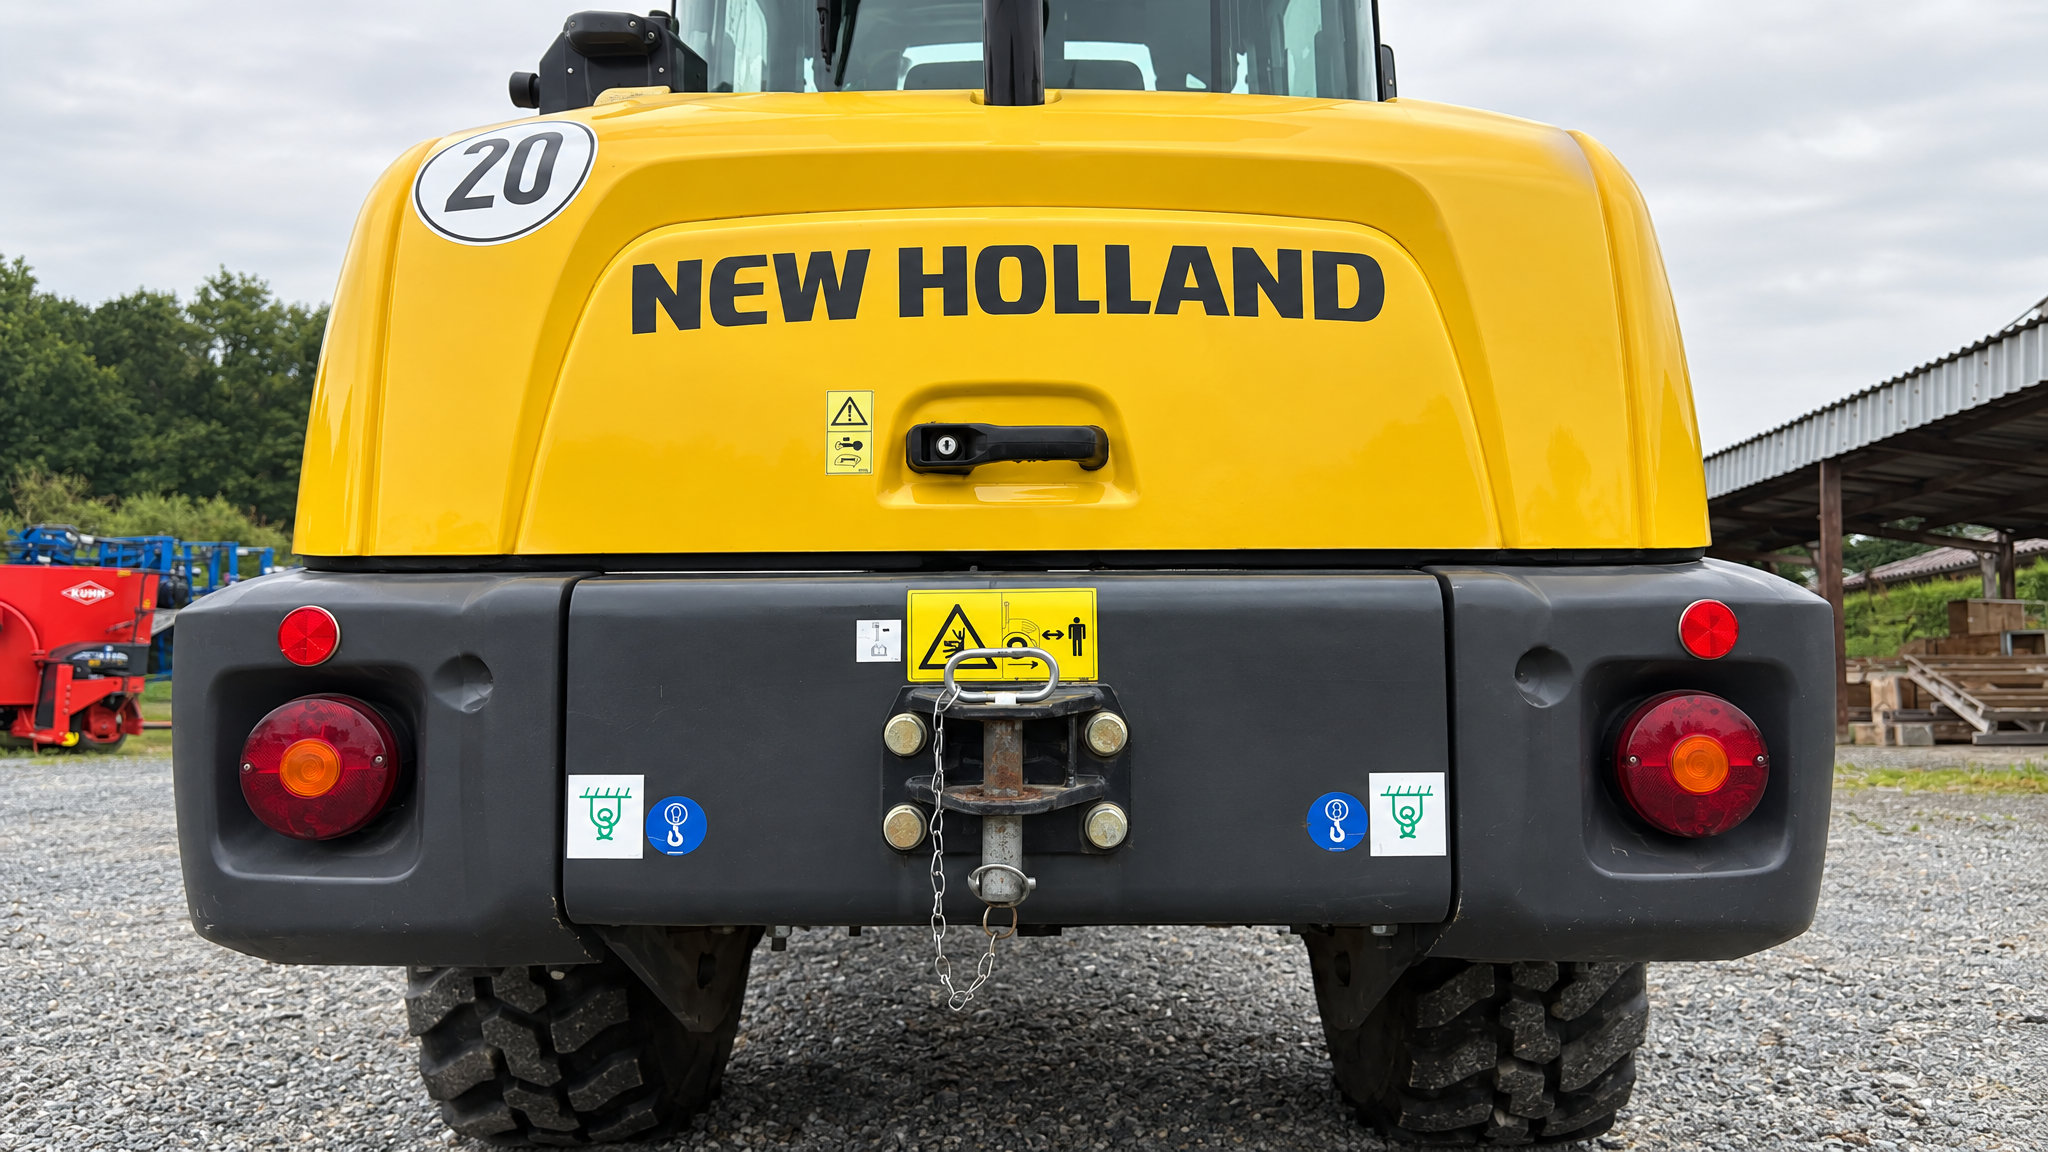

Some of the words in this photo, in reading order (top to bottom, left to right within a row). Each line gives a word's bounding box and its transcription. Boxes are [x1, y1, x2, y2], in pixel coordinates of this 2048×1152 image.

[444, 131, 564, 213] 20
[631, 248, 871, 335] NEW
[898, 244, 1385, 323] HOLLAND
[70, 588, 106, 599] KUHN
